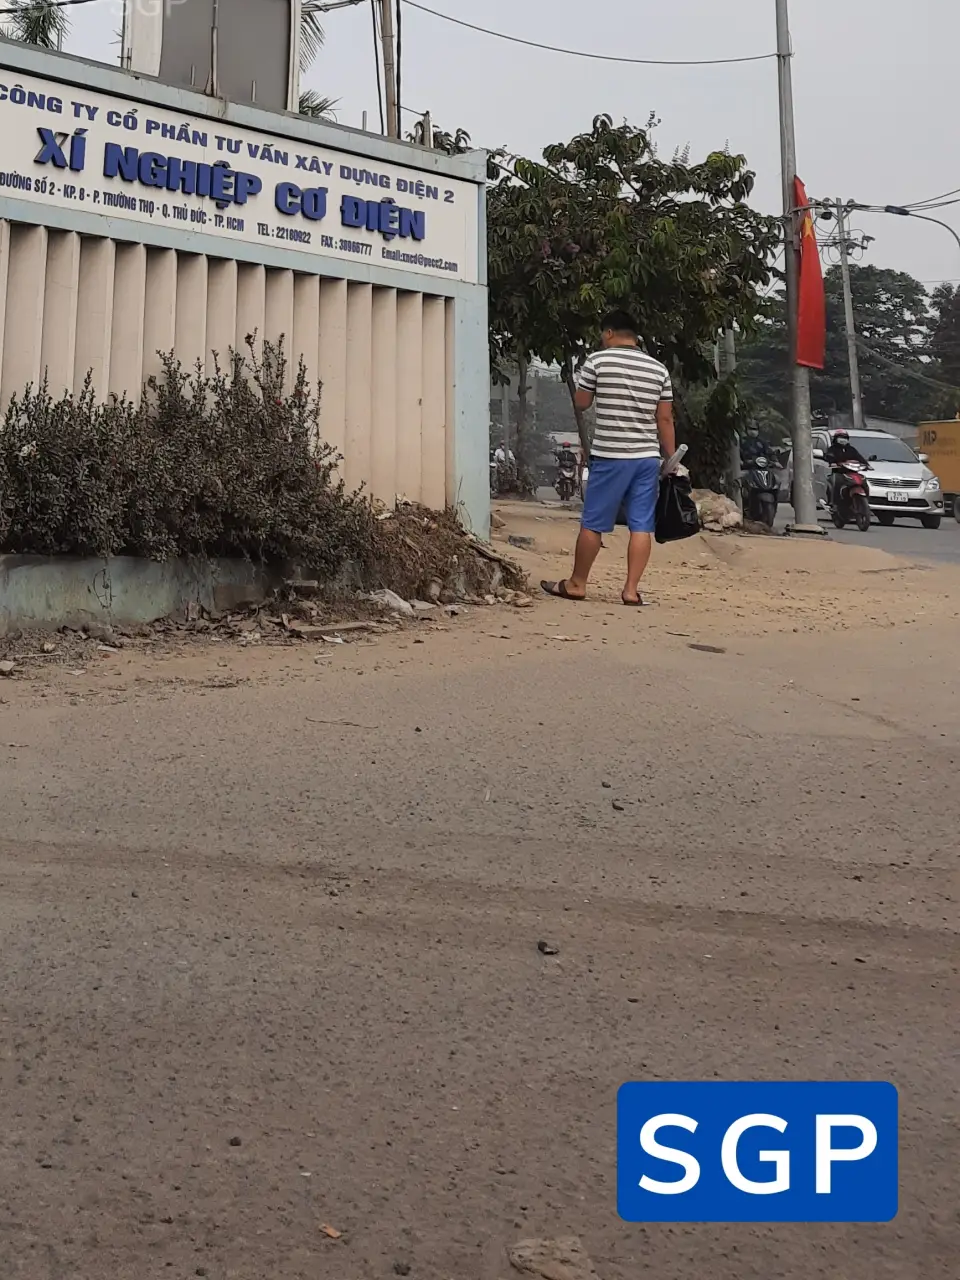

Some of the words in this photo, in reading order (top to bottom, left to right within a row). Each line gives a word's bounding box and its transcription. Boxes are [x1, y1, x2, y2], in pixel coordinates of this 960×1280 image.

[34, 127, 89, 171] XÍ
[103, 142, 262, 209] NGHIỆP
[275, 181, 328, 221] CƠ
[340, 194, 426, 241] ĐIỆN
[71, 101, 99, 121] TY
[106, 109, 138, 131] CỔ
[146, 119, 207, 147] PHẦN
[215, 135, 243, 154] TƯ
[247, 143, 289, 166] VẤN
[294, 155, 334, 176] XÂY
[340, 165, 391, 188] DỰNG
[396, 177, 439, 200] ĐIỆN
[444, 190, 455, 203] 2
[0, 171, 32, 191] ĐƯỜNG
[34, 175, 47, 193] SỐ
[49, 182, 55, 195] 2
[63, 184, 77, 200] KP.
[79, 188, 85, 201] 8
[93, 190, 100, 204] P.
[103, 191, 137, 211] TRƯỜNG
[139, 198, 154, 218] THỌ
[162, 204, 170, 219] Q.
[172, 203, 188, 221] THỦ
[190, 207, 207, 224] ĐỨC
[214, 214, 225, 228] TP.
[227, 217, 245, 231] HCM
[257, 223, 270, 236] TEL
[320, 235, 333, 248] FAX
